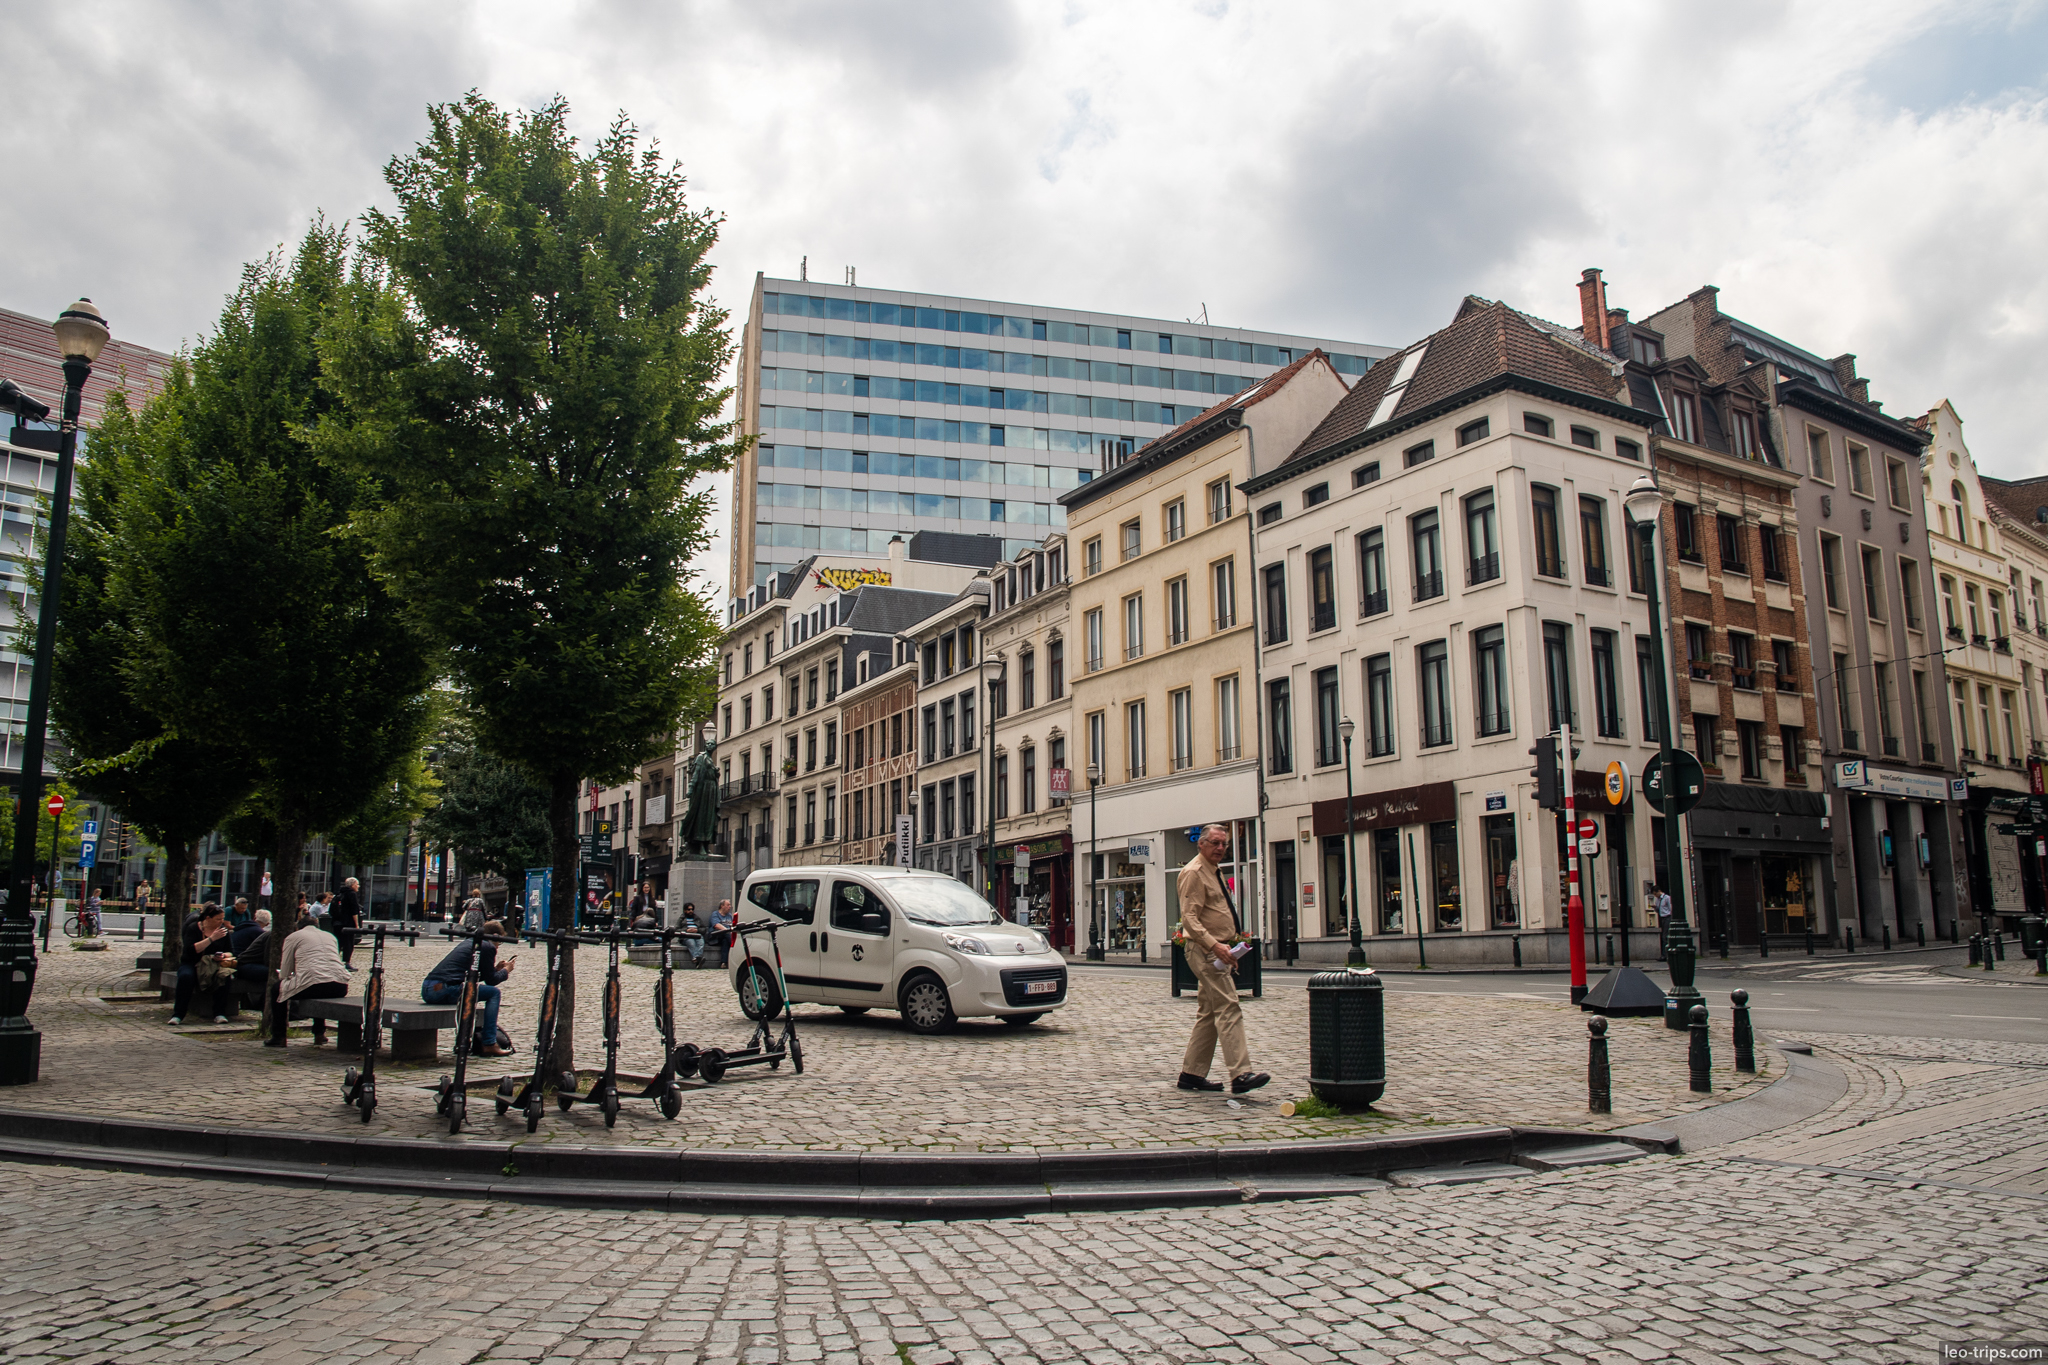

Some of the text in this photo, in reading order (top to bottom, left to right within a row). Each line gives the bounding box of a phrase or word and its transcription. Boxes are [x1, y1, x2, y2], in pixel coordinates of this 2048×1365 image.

[601, 824, 608, 832] P
[82, 843, 94, 858] P
[901, 820, 910, 864] Putiikki
[470, 950, 481, 971] flash
